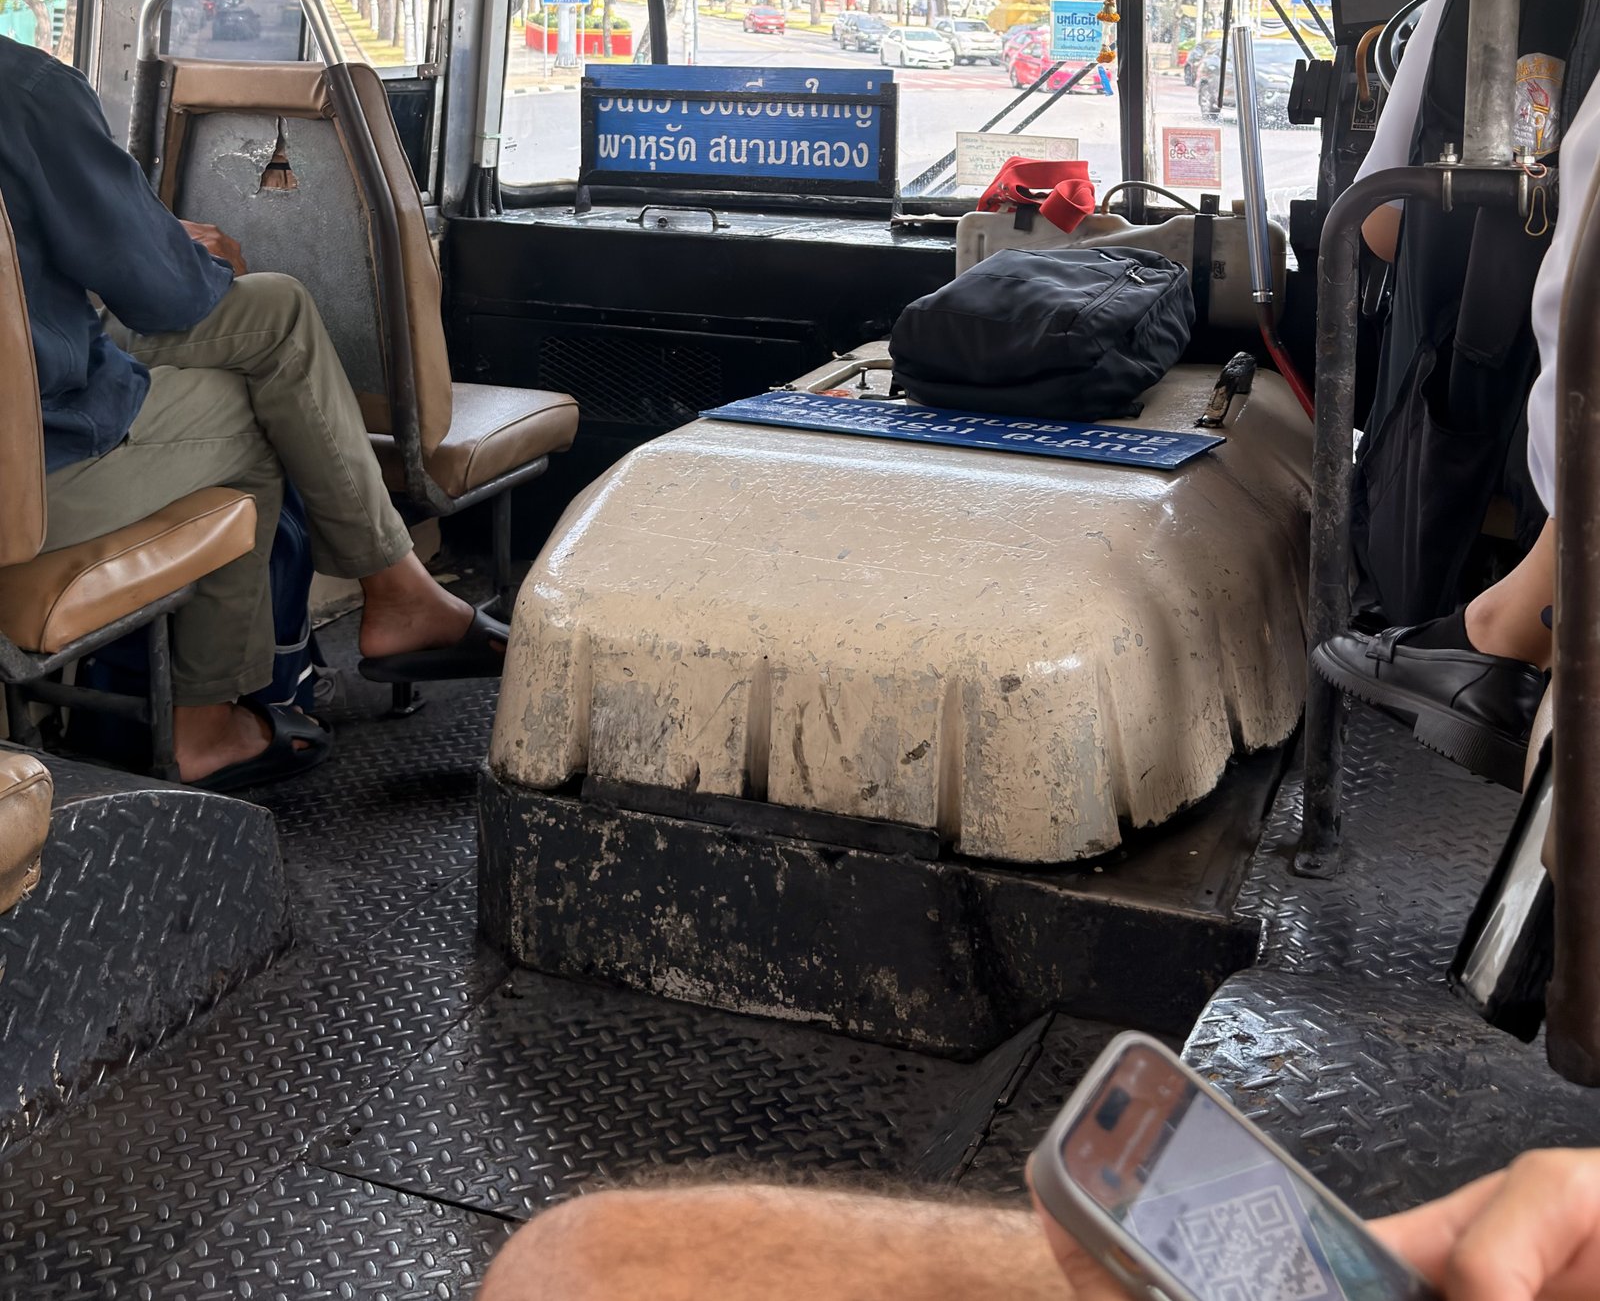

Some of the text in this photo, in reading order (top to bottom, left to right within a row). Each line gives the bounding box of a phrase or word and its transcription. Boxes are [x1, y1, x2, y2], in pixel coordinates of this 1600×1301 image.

[1061, 28, 1096, 42] 1484
[598, 123, 870, 171] พาหุรัด สนามหลวง
